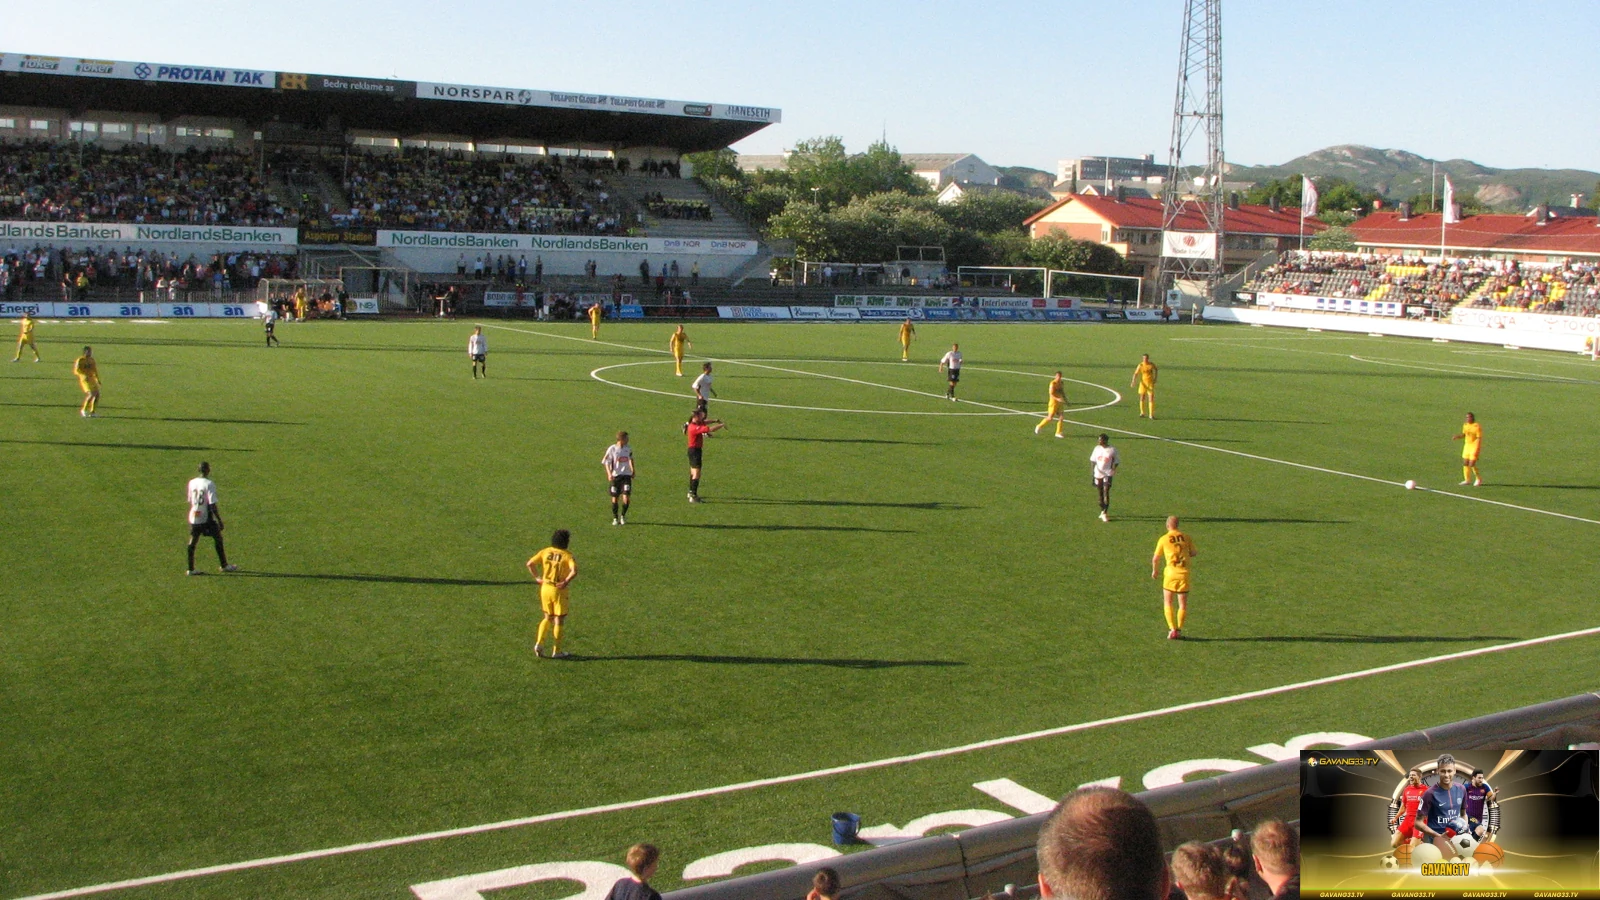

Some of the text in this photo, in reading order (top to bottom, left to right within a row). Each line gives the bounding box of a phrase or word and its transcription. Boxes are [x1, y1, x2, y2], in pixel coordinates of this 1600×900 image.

[157, 66, 265, 85] PROTAN TAK
[323, 78, 395, 92] Bedre reklame as
[433, 86, 515, 102] NORSPAR
[137, 227, 282, 243] NordlandsBanken
[391, 232, 519, 248] NordlandsBanken
[531, 236, 649, 251] NordlandsBanken
[0, 303, 40, 316] Energi
[68, 306, 91, 316] an
[120, 306, 142, 316] an
[173, 306, 194, 316] an
[223, 306, 245, 316] an
[1169, 535, 1185, 543] an
[547, 552, 562, 562] an
